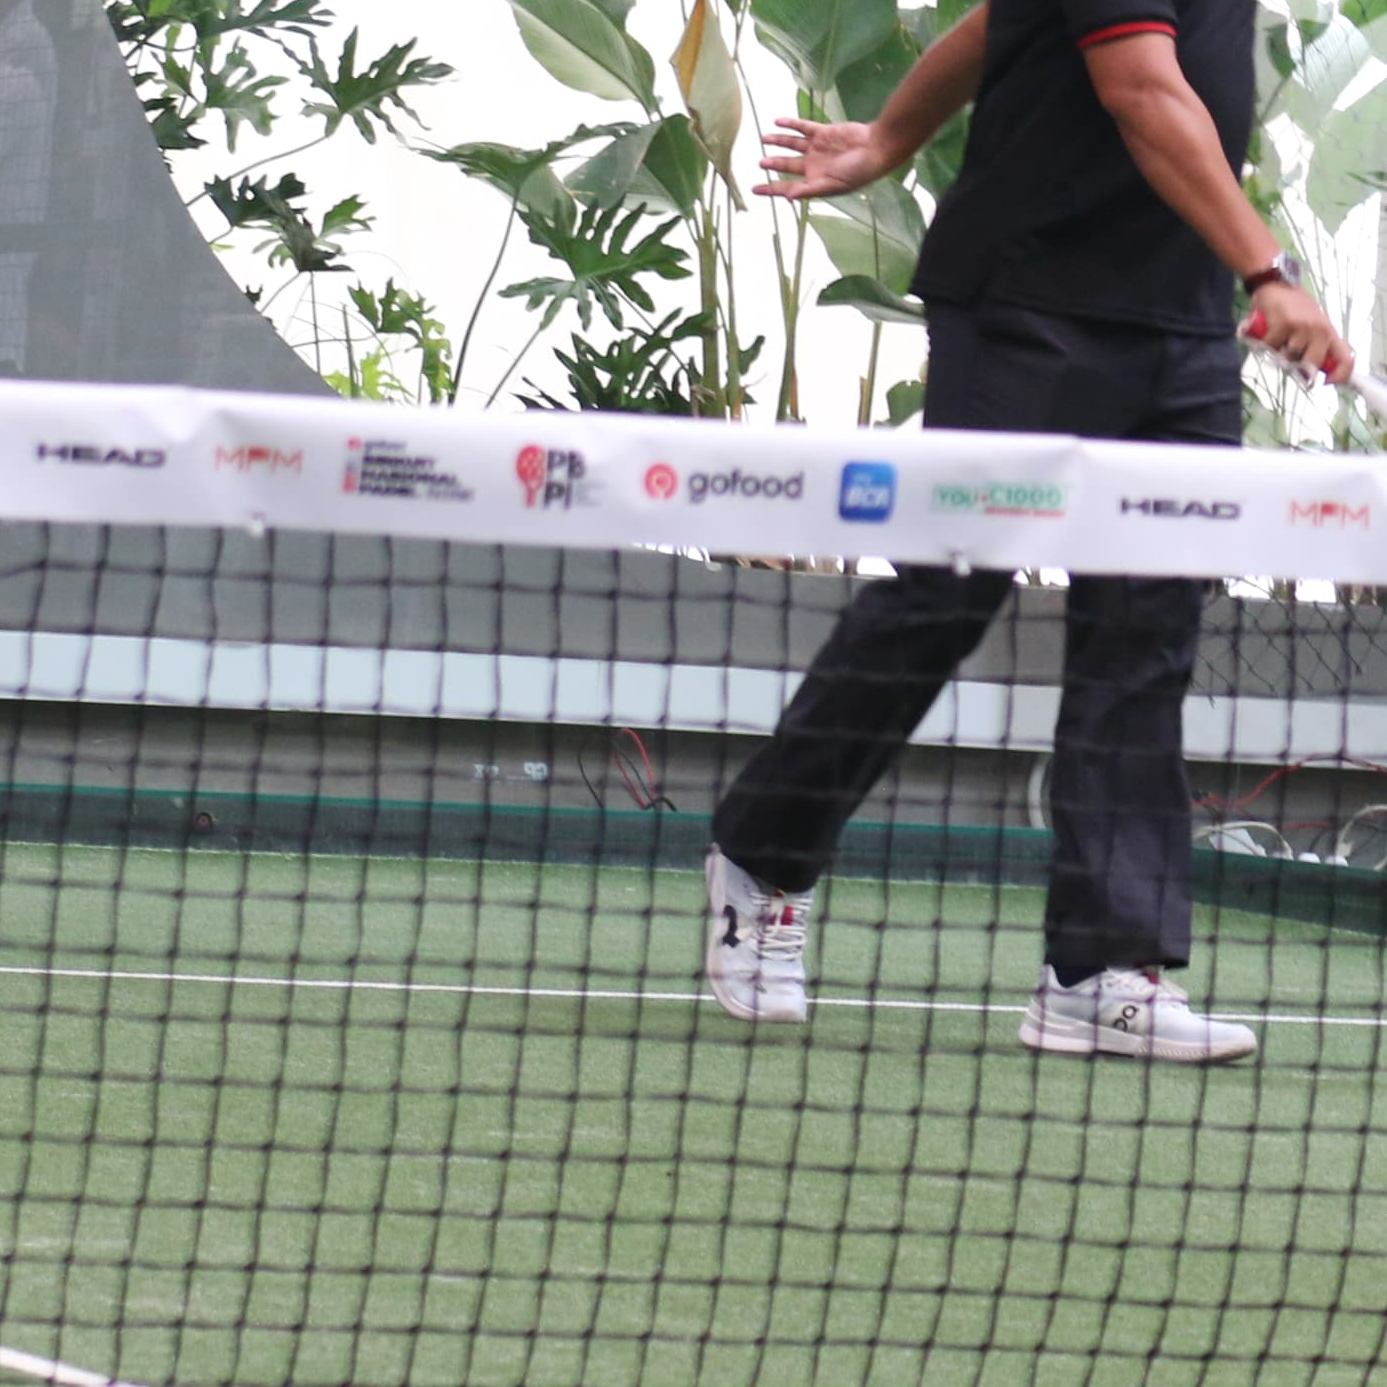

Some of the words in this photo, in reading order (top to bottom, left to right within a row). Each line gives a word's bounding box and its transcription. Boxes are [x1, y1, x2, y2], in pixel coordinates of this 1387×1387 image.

[36, 442, 167, 469] HEAD
[546, 448, 587, 481] PB
[542, 481, 572, 512] PI
[687, 465, 804, 505] gofood
[1119, 496, 1242, 522] HEAD
